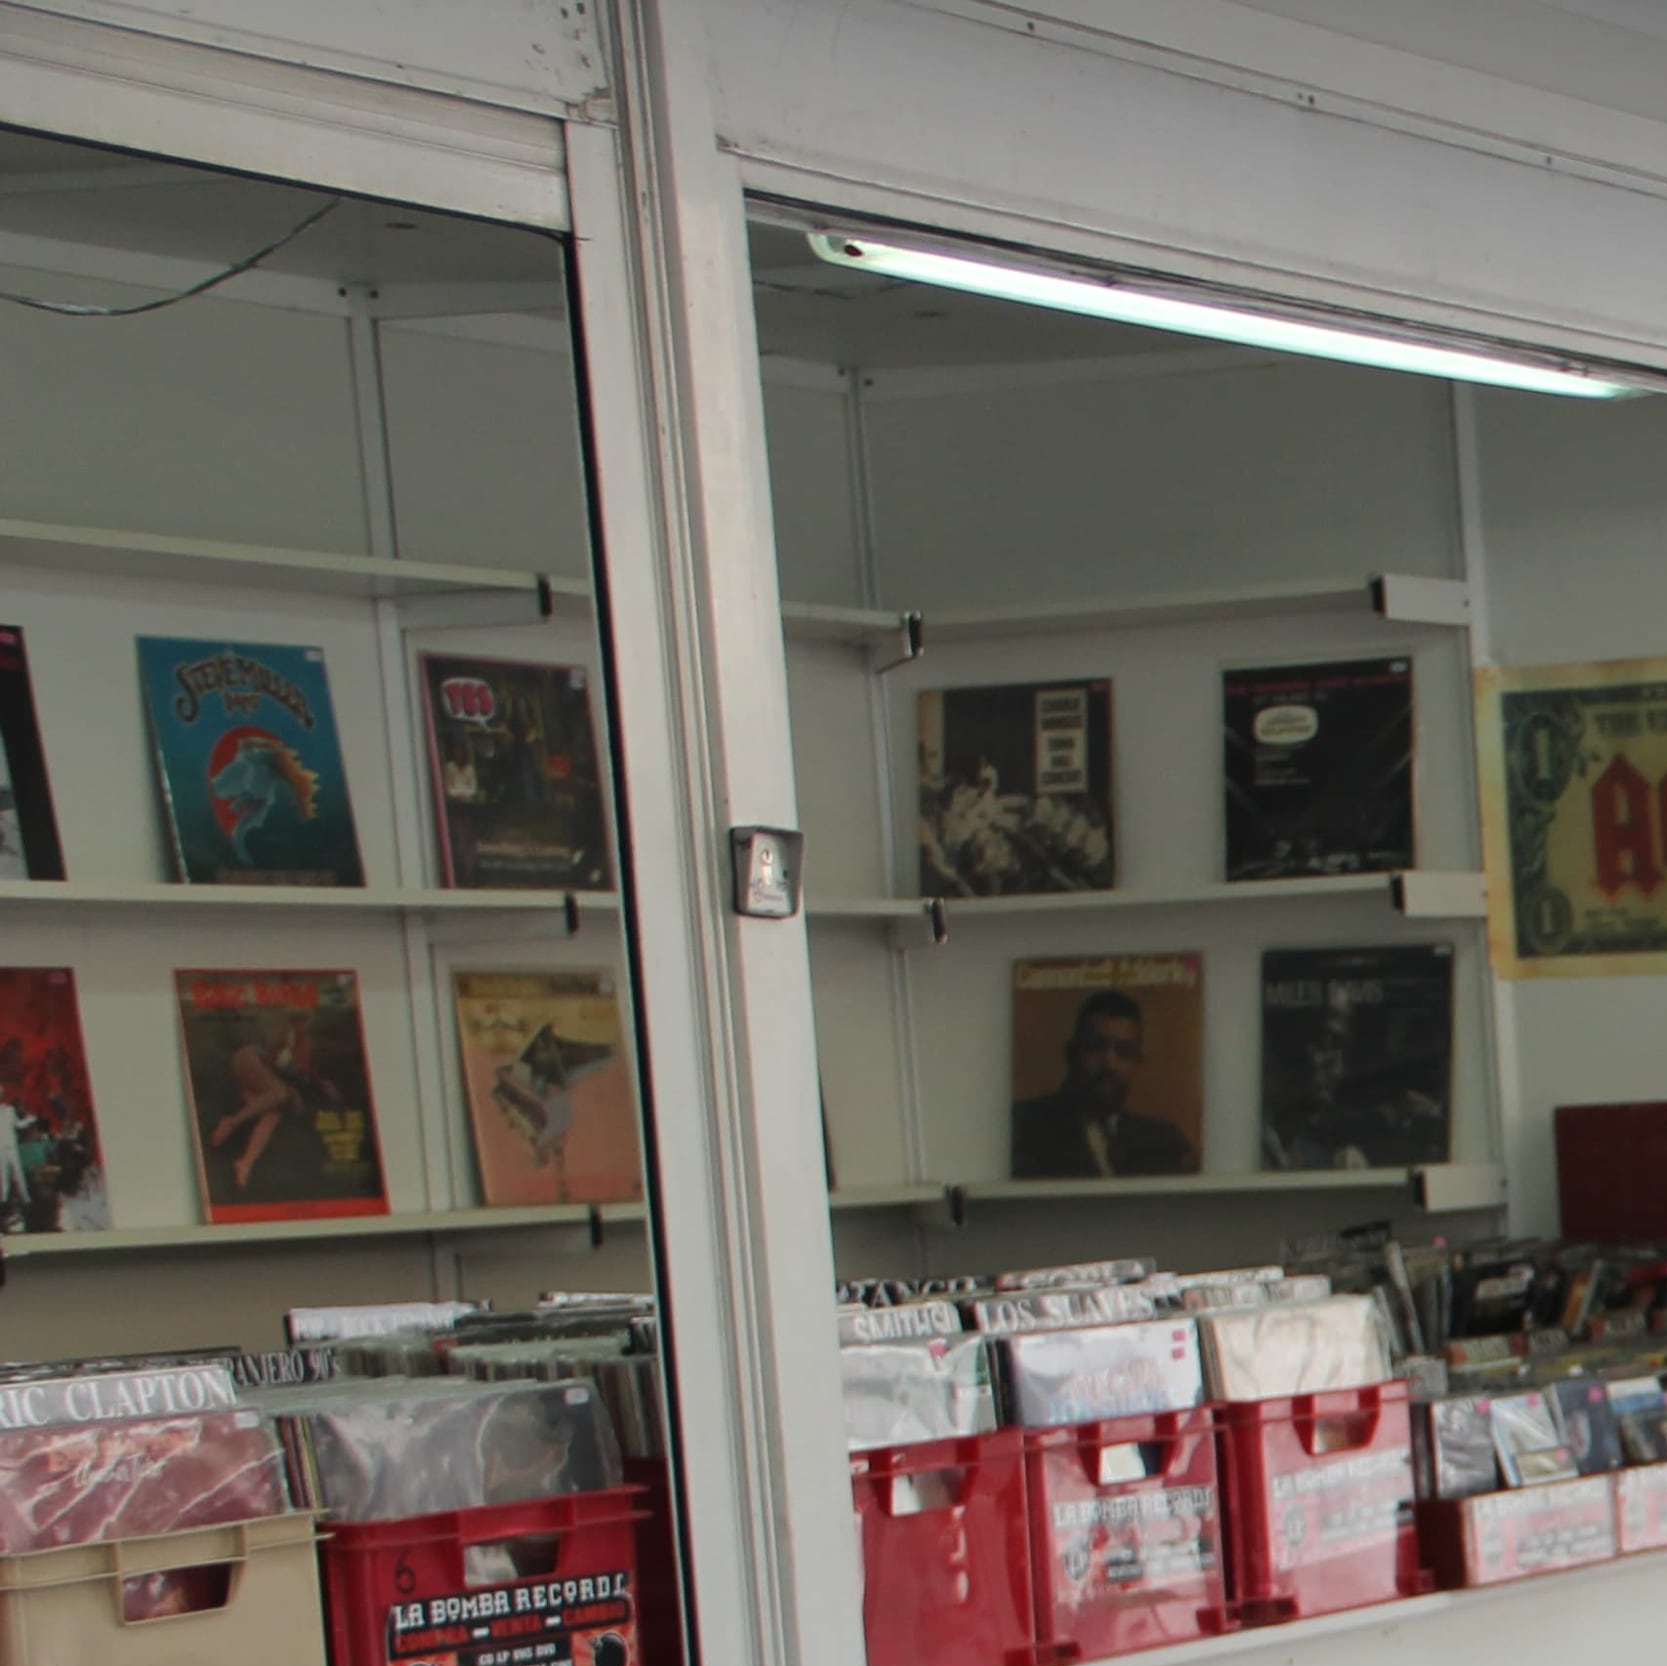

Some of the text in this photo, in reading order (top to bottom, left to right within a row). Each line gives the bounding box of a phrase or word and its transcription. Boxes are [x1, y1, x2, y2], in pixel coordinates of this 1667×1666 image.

[176, 653, 240, 722] STEVE
[977, 1297, 1035, 1333] LOS
[64, 1370, 238, 1423] CLAPTON
[393, 1551, 416, 1594] 6
[394, 1572, 629, 1631] LA BOMBA RECORDS
[496, 1651, 510, 1664] LP
